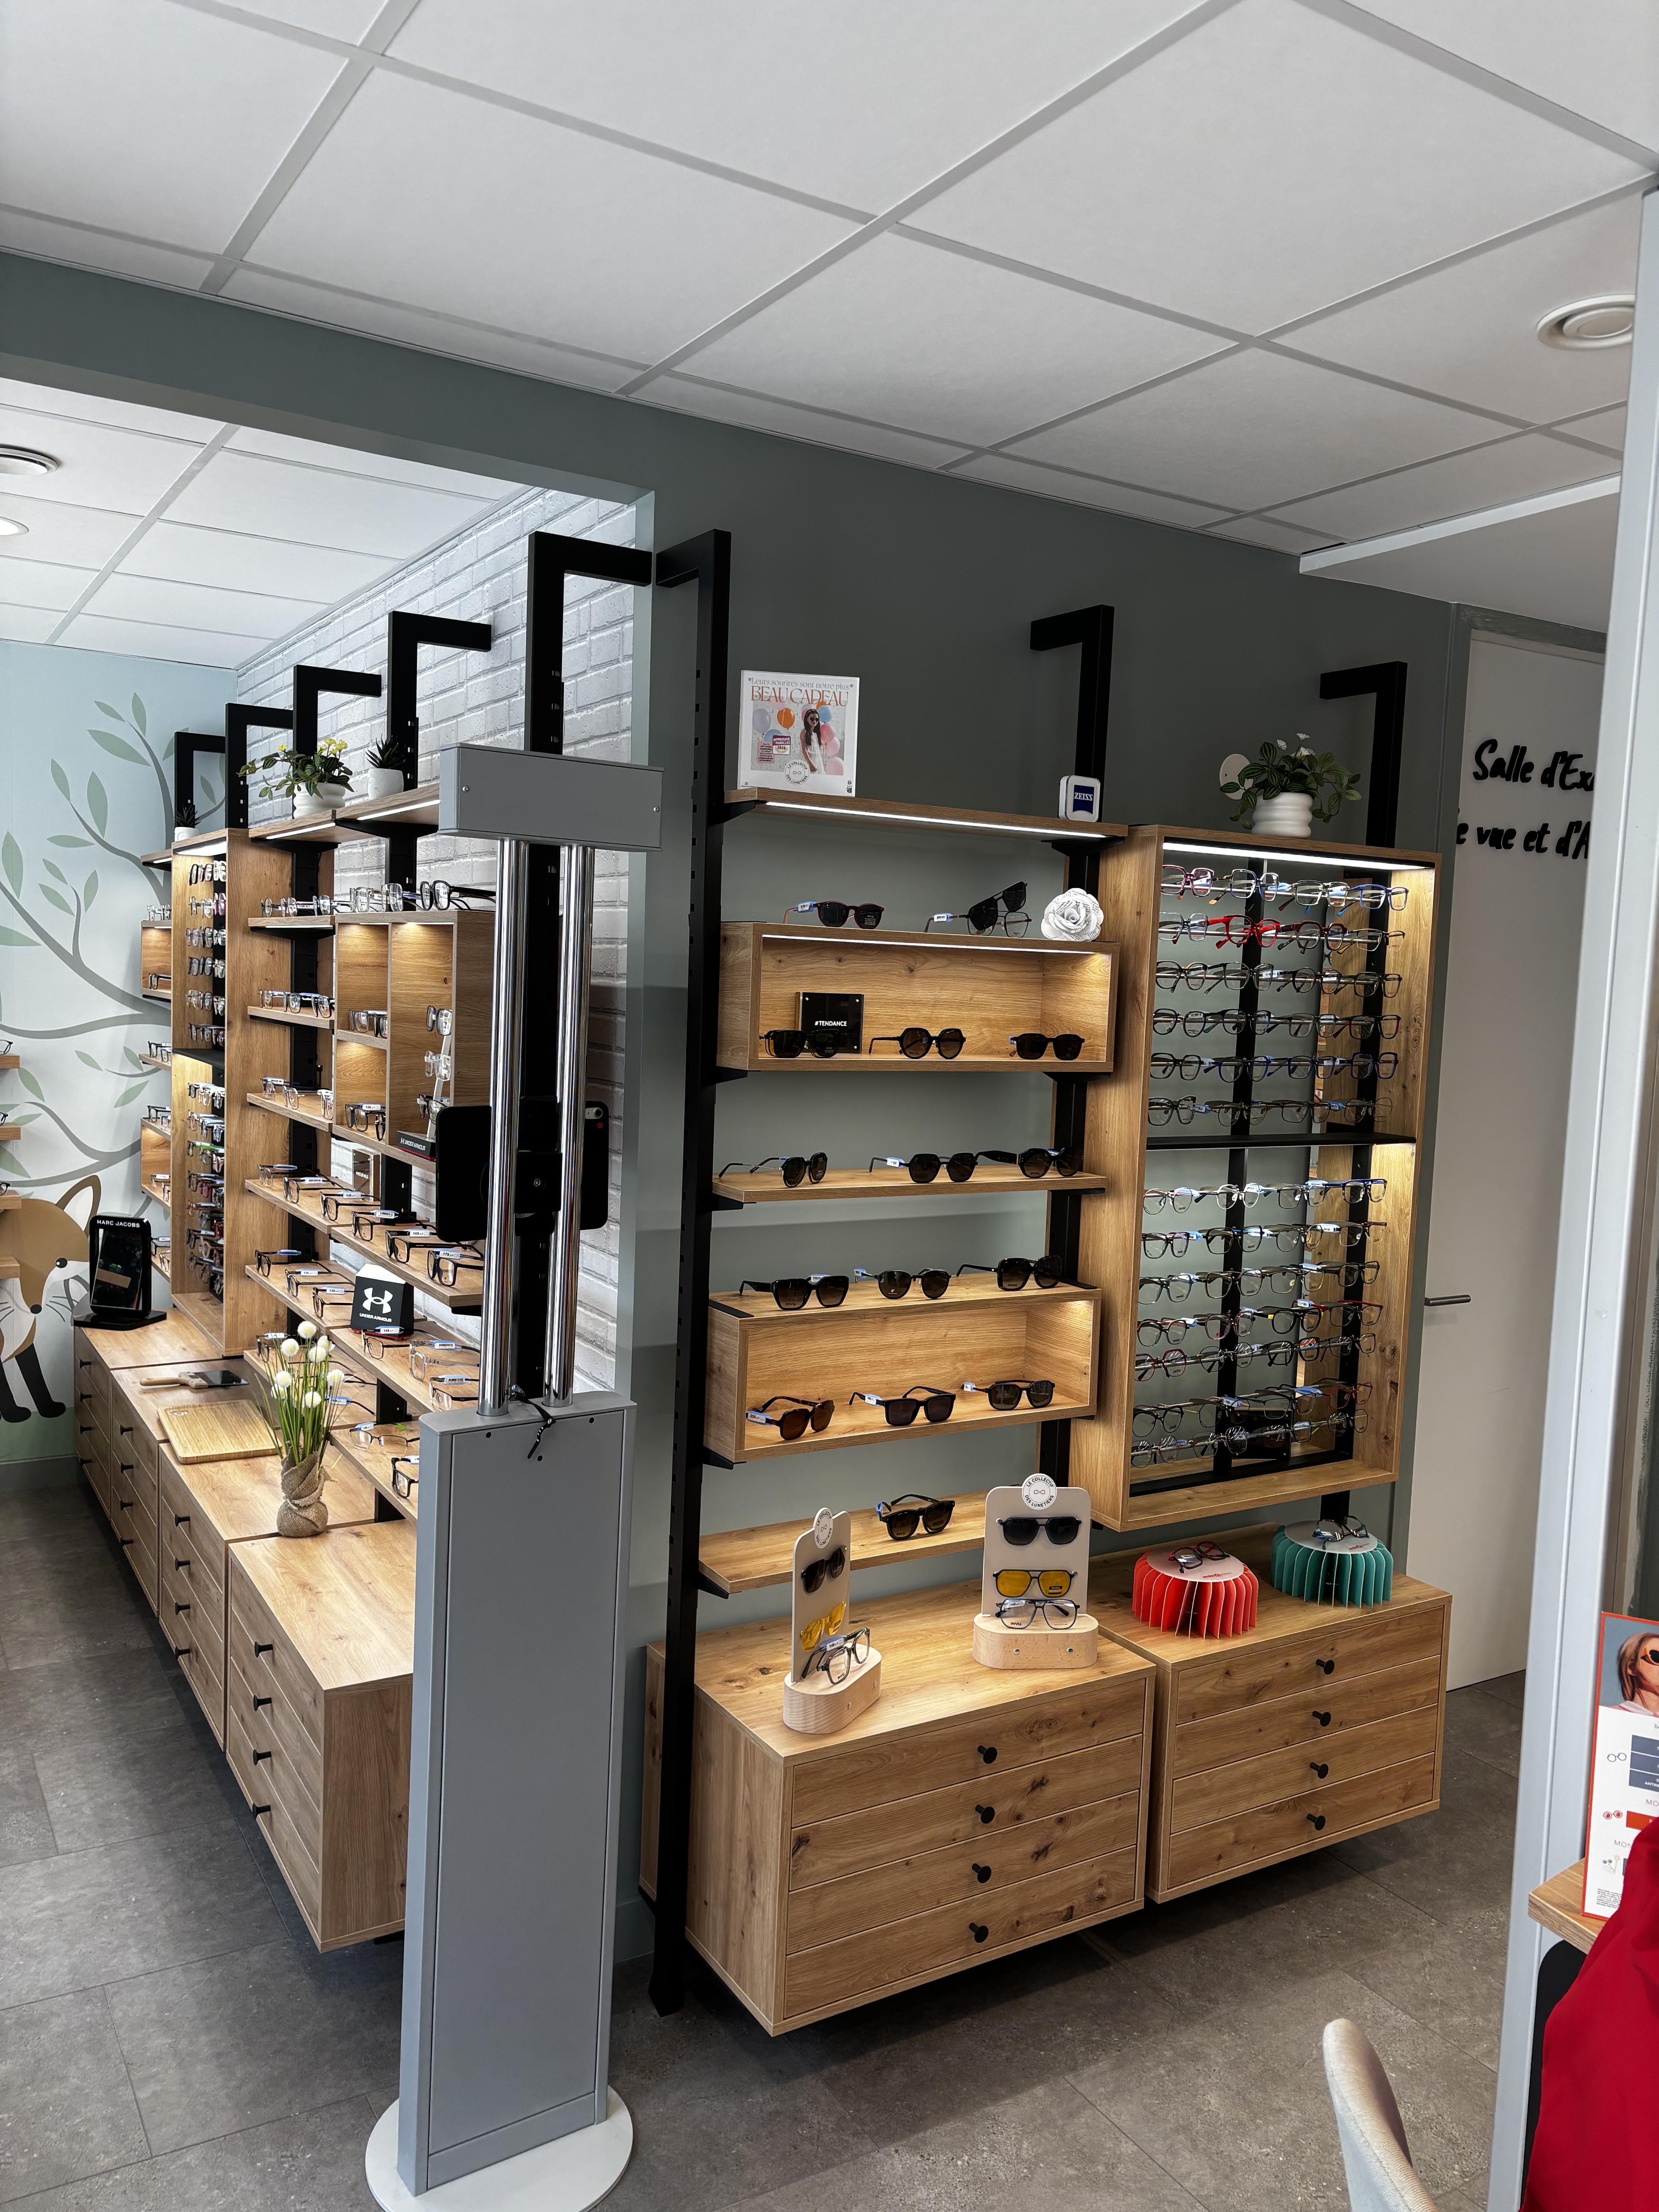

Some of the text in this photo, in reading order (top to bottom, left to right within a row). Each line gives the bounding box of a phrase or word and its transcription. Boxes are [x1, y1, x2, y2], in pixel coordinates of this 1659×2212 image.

[751, 686, 849, 706] BEAU CADEAU
[1473, 739, 1595, 791] Salle d'Ex
[1074, 792, 1093, 801] ZEISS
[1477, 826, 1517, 849] vue
[1523, 823, 1550, 853] et
[414, 1143, 426, 1151] ARMOUR
[1031, 1477, 1054, 1488] COLLECTIF
[1031, 1495, 1054, 1508] LUNETIERS
